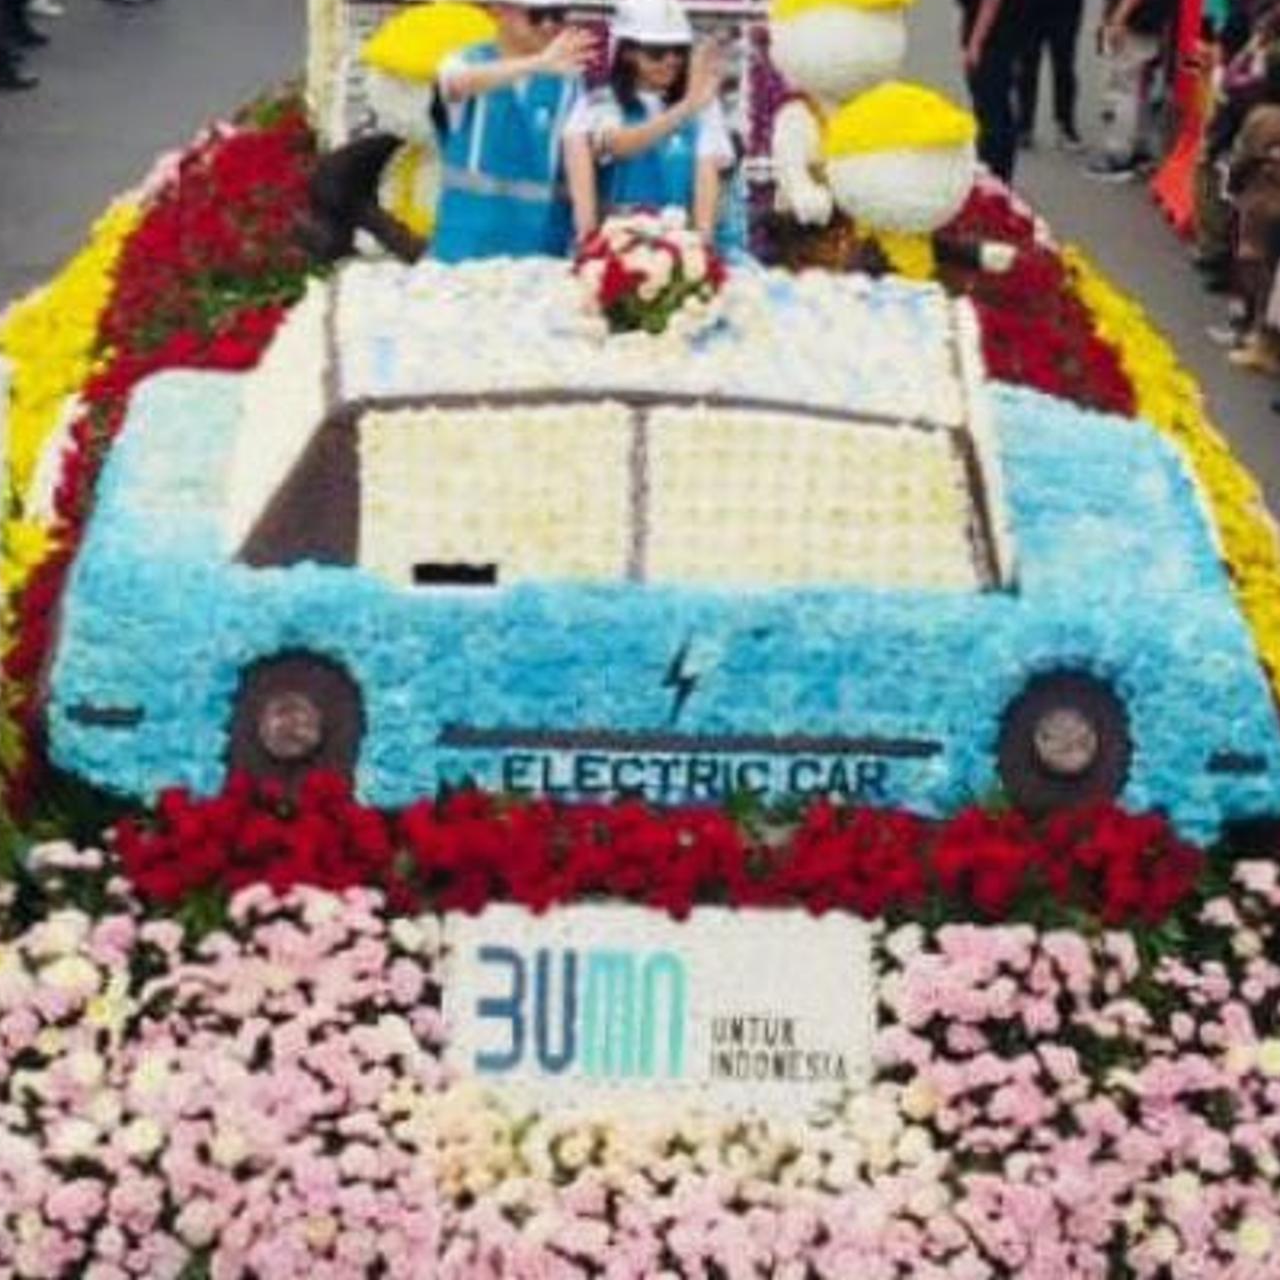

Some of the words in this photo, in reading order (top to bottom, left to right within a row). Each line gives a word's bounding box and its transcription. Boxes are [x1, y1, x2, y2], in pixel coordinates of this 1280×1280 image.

[502, 753, 774, 800] ELECTRIC
[787, 757, 891, 800] CAR
[710, 1015, 796, 1047] UNTUK
